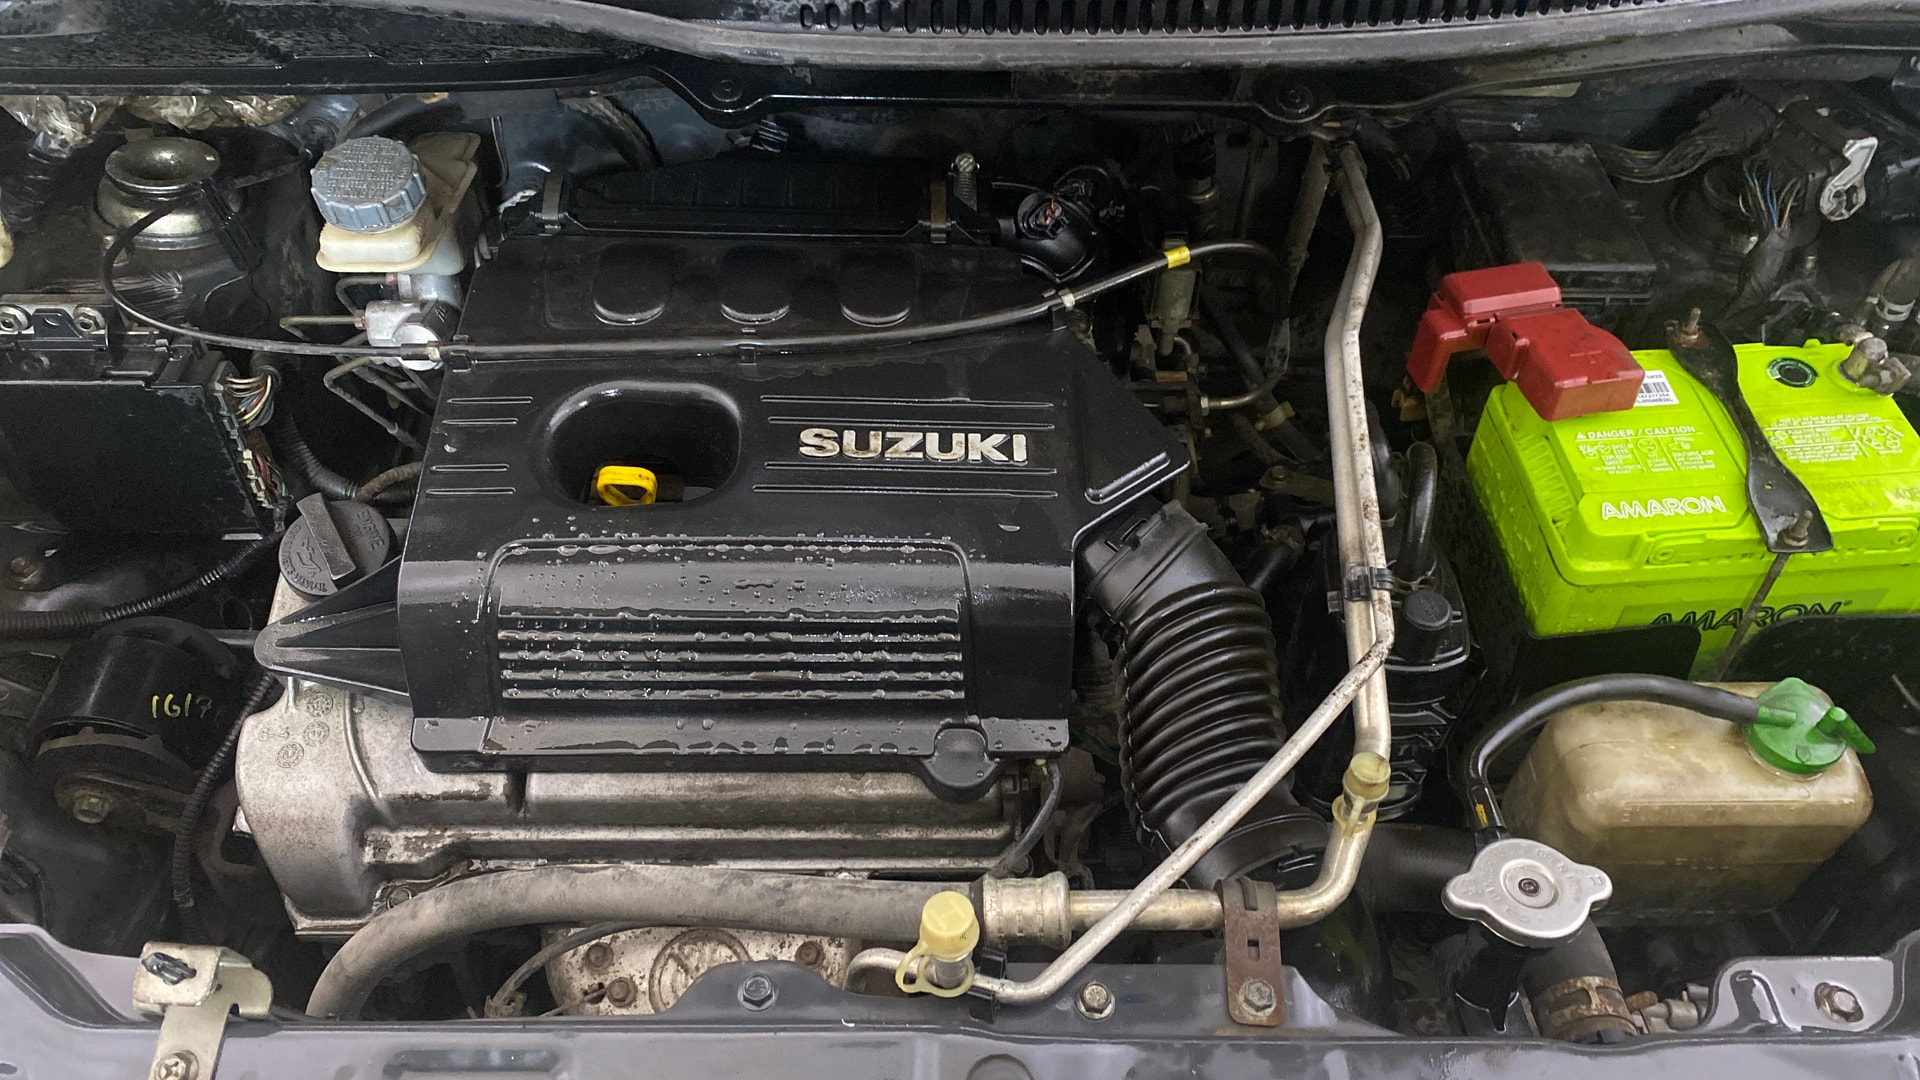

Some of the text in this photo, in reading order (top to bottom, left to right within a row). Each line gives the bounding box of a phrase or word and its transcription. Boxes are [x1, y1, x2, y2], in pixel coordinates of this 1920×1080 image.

[799, 428, 1027, 464] SUZUKI
[1587, 429, 1634, 439] DANGER
[1645, 426, 1695, 436] CAUTION
[1602, 495, 1727, 520] AMARON
[356, 508, 386, 551] ENGINE
